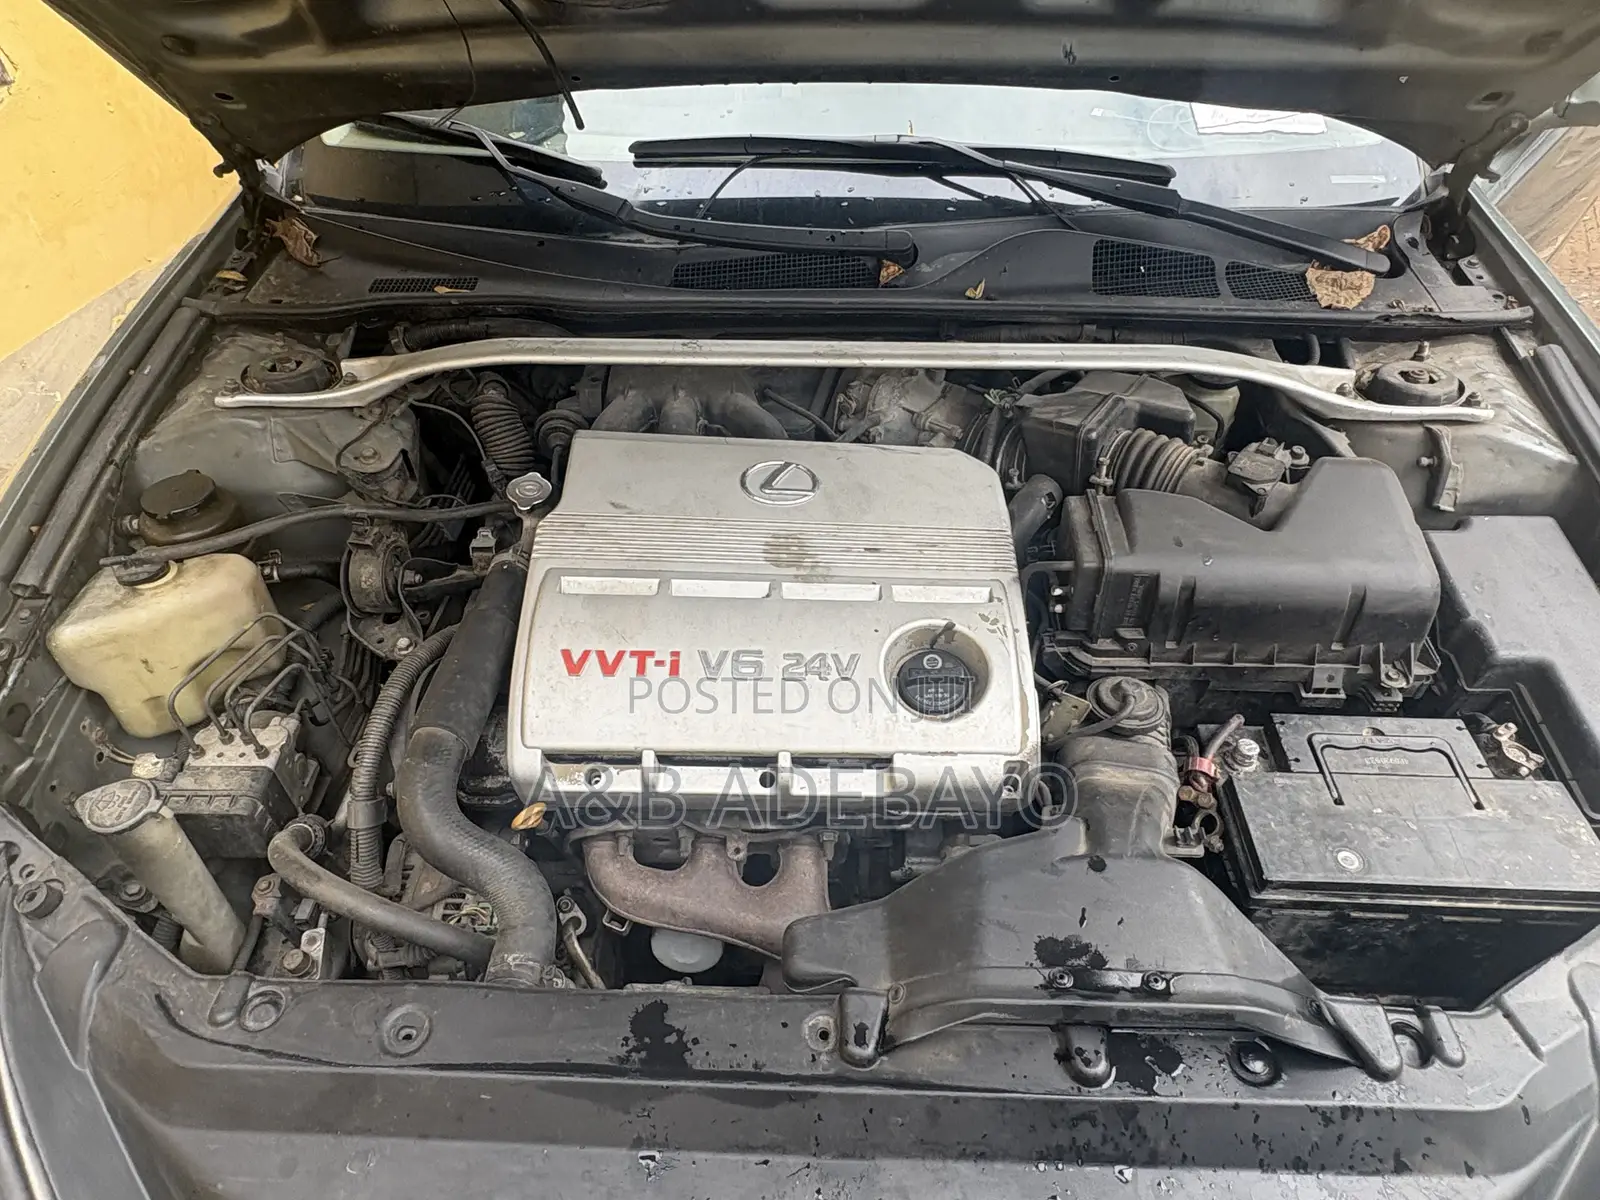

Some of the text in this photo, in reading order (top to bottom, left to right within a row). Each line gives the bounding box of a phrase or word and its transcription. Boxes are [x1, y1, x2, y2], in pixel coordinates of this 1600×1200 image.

[560, 648, 861, 681] VVT-i V6 24V
